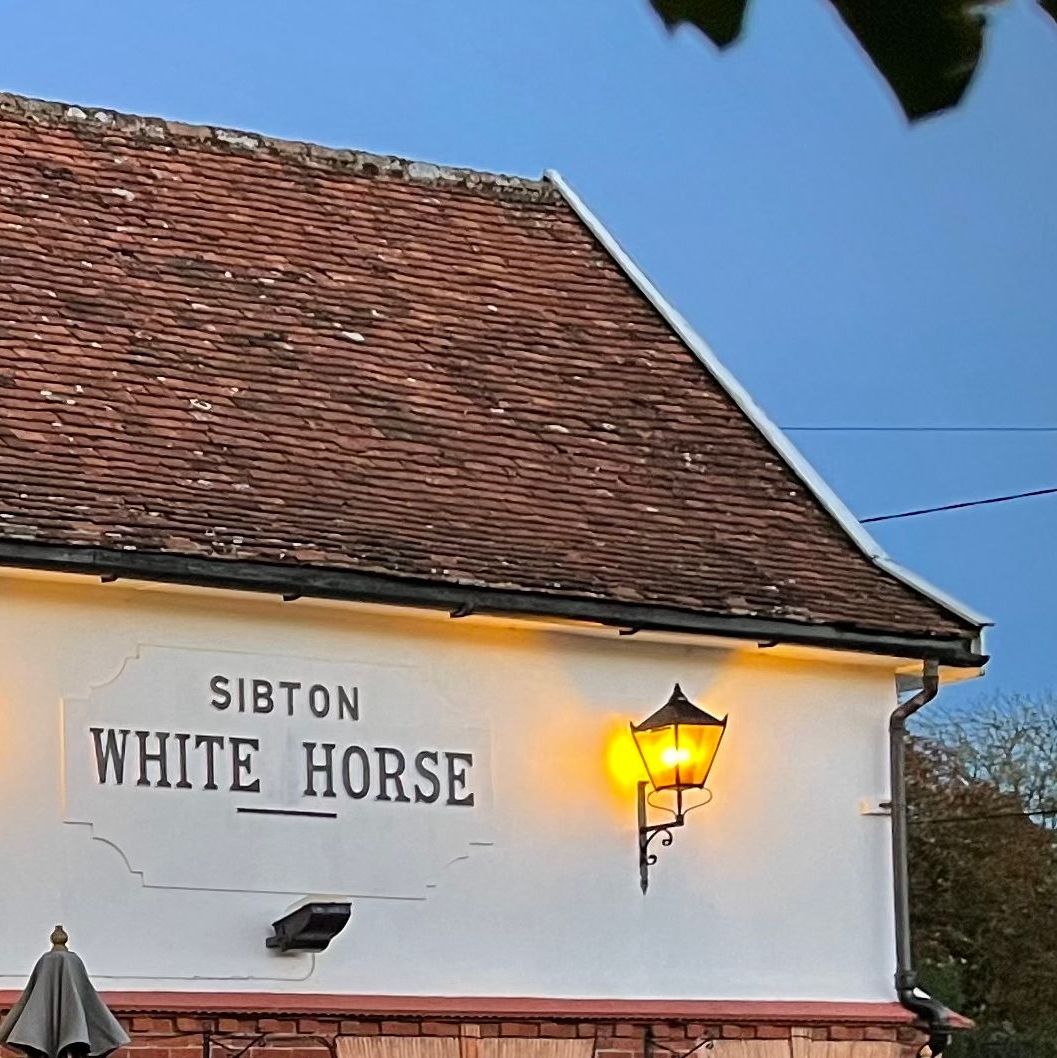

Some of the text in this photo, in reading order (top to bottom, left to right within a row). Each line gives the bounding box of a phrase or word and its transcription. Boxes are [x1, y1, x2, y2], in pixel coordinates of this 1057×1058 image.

[210, 675, 359, 721] SIBTON
[89, 727, 475, 807] WHITE HORSE
